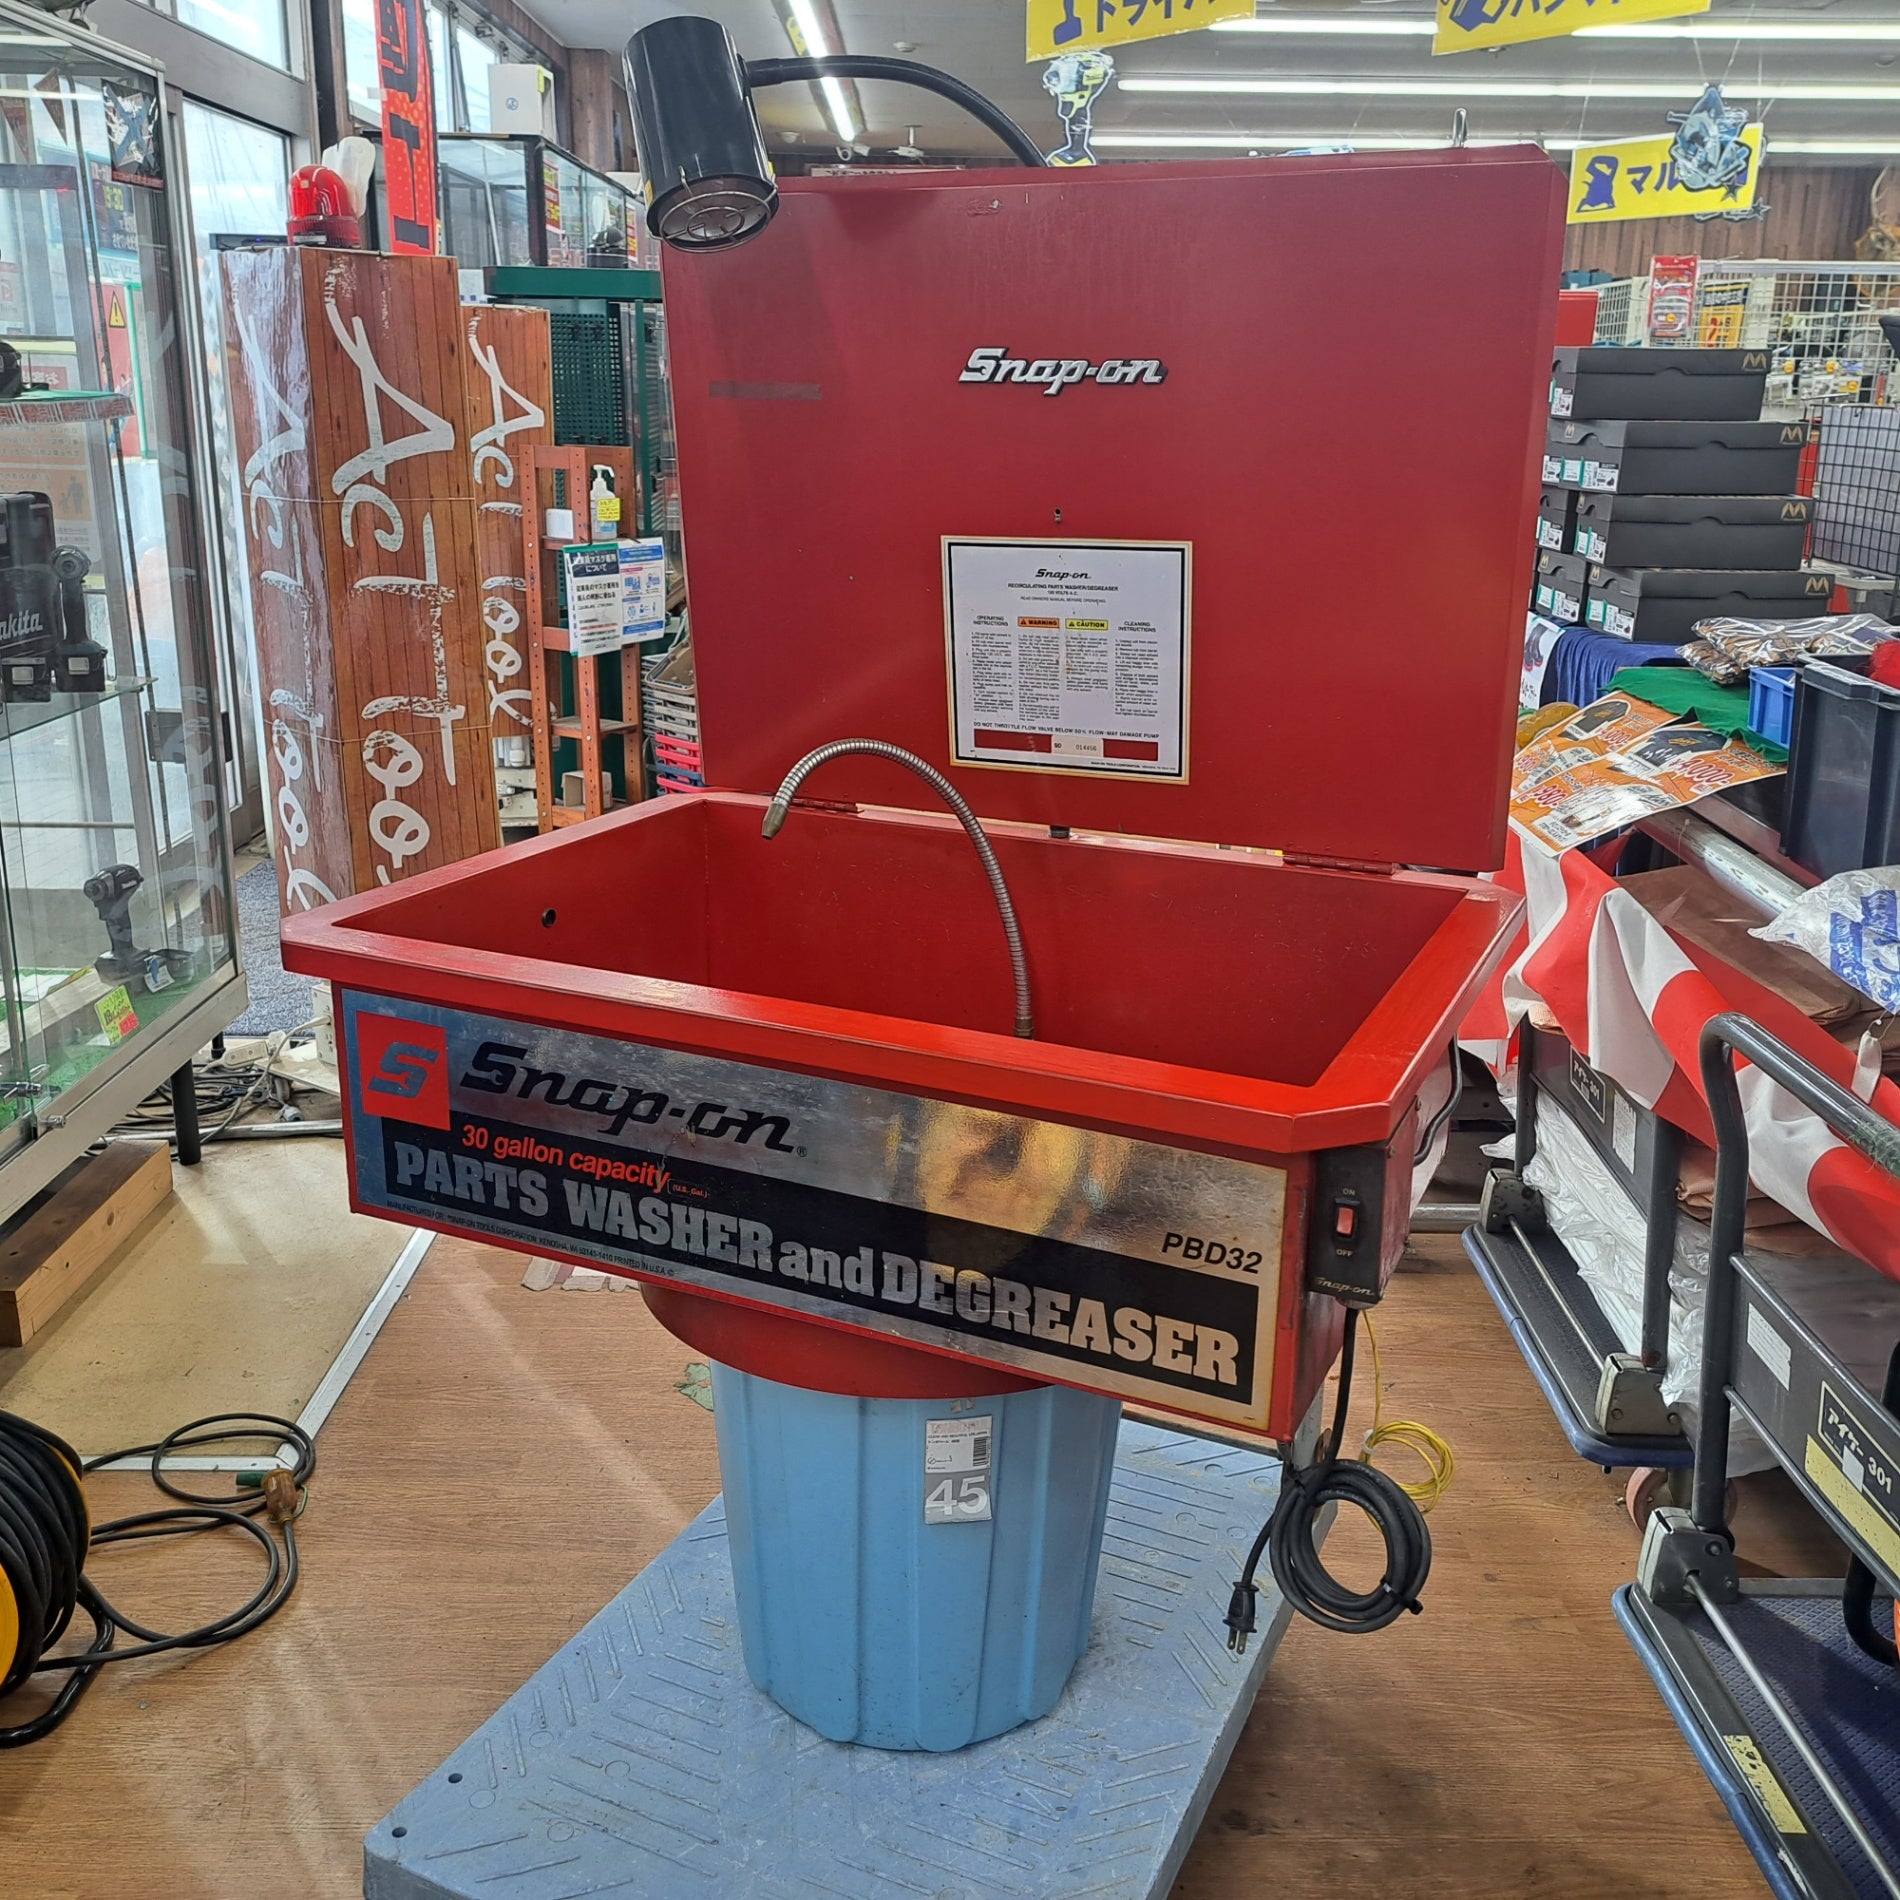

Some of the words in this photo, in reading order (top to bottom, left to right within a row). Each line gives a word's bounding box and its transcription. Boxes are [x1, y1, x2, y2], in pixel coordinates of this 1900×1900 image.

[958, 347, 1167, 396] Snap-on
[1035, 568, 1089, 581] Snap-on
[1028, 619, 1058, 627] WARNING
[459, 1041, 796, 1153] Snap-on
[462, 1124, 488, 1149] 30
[494, 1133, 563, 1167] gallon
[568, 1149, 673, 1194] capacity
[1342, 1188, 1356, 1196] ON
[394, 1141, 548, 1218] PARTS
[562, 1177, 773, 1274] WASHER
[778, 1241, 875, 1296] and
[882, 1250, 1240, 1387] DEGREASER
[614, 1256, 640, 1268] PRINTED
[641, 1261, 648, 1270] IN
[1162, 1232, 1263, 1275] PBD32
[1336, 1248, 1353, 1257] OFF
[1315, 1277, 1375, 1297] Snap-on
[1867, 1456, 1893, 1495] 301
[925, 1475, 988, 1516] 45
